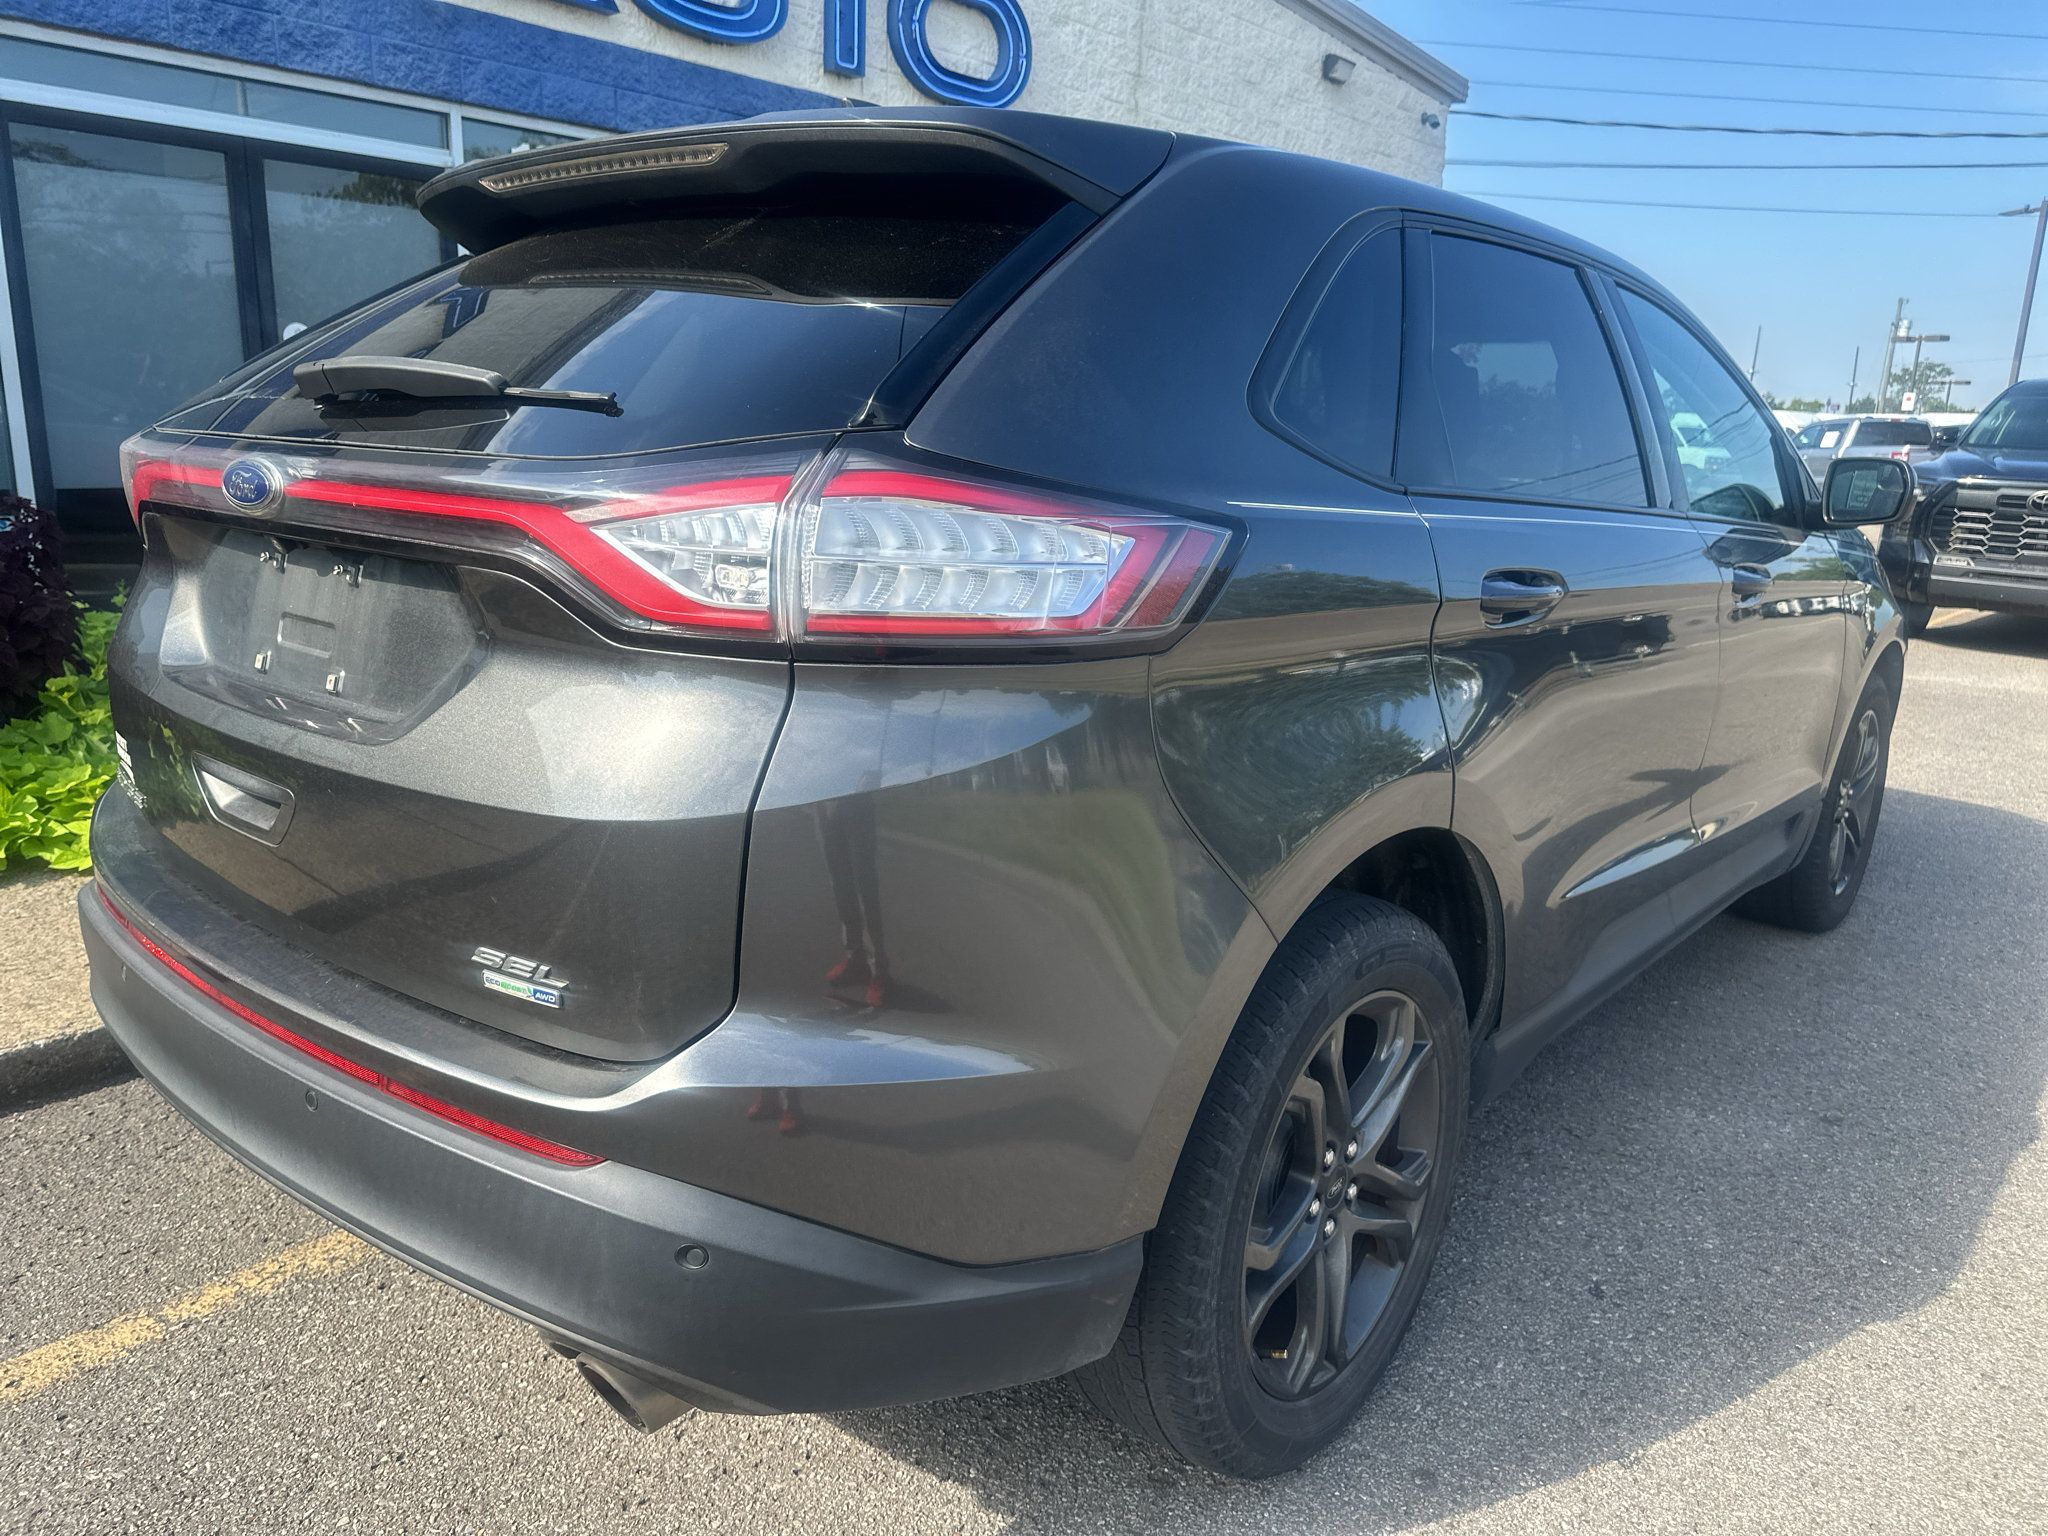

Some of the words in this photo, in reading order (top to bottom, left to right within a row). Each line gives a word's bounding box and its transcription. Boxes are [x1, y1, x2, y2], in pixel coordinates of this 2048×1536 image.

[230, 470, 258, 499] Ford
[471, 946, 569, 987] SEL
[534, 991, 556, 1003] AWD
